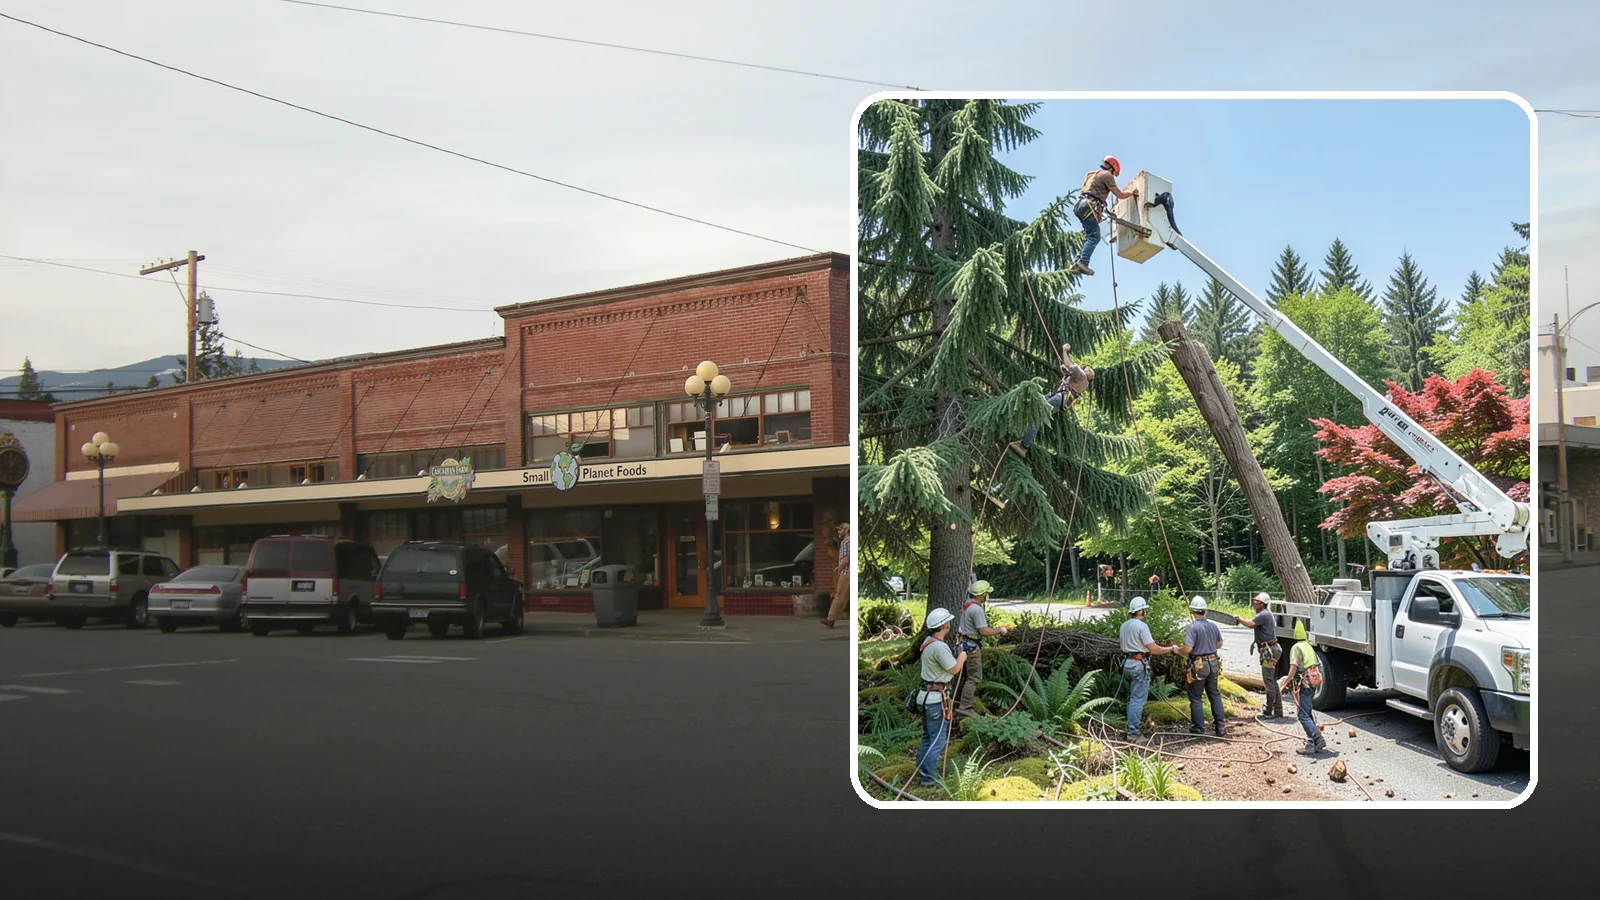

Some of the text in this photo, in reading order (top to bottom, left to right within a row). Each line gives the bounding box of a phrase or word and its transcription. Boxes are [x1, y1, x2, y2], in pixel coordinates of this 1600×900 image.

[523, 464, 647, 483] Small Planet Foods
